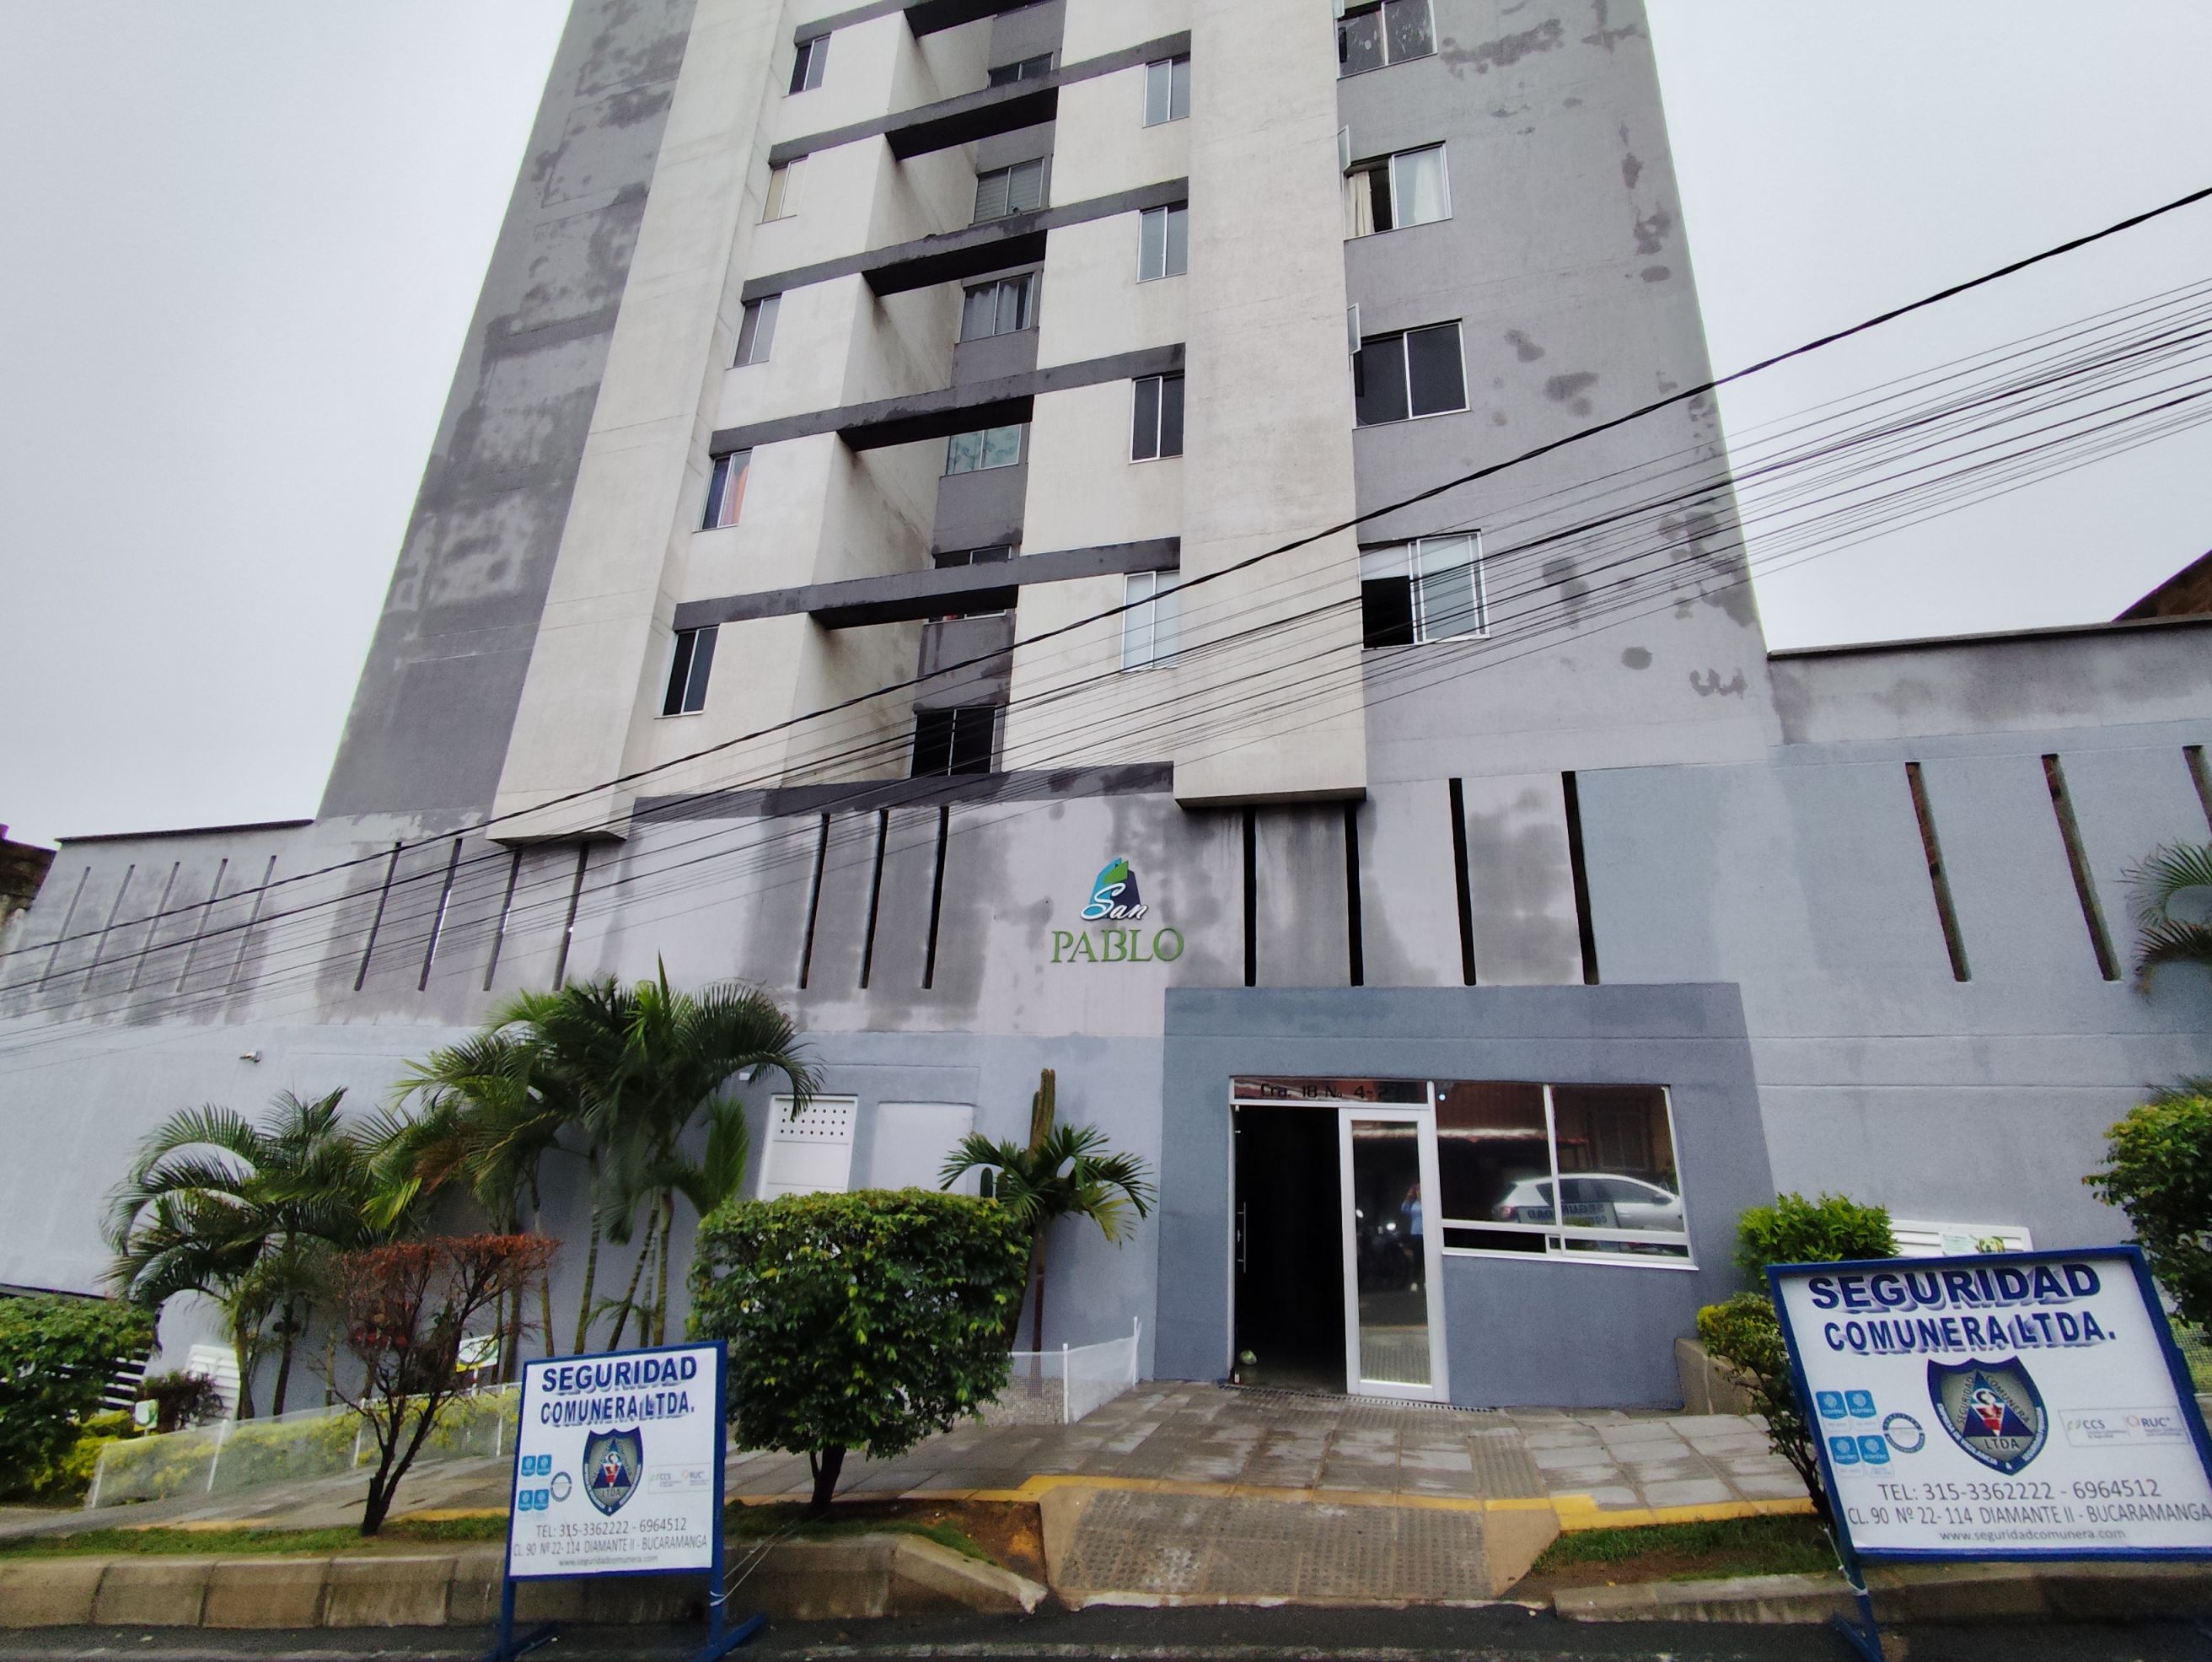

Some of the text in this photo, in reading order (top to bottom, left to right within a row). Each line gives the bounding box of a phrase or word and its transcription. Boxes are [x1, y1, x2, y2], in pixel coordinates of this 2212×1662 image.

[1080, 883, 1148, 921] San
[1050, 928, 1184, 963] PABLO
[1261, 1084, 1291, 1097] Cra.
[1302, 1085, 1318, 1098] 18
[1808, 1263, 2102, 1310] SEGURIDAD
[1825, 1310, 2117, 1351] COMUNERA LTDA.
[542, 1356, 697, 1393] SEGURIDAD
[540, 1391, 695, 1424] COMUNERA LTDA.
[1957, 1376, 1975, 1424] SEGURIDAD
[1985, 1375, 2031, 1423] COMUNERA
[2082, 1419, 2106, 1429] CCS
[1984, 1439, 2021, 1451] LTDA
[1877, 1483, 1918, 1501] TEL:
[1923, 1482, 2054, 1501] 315-3362222
[2073, 1478, 2161, 1499] 6964512
[537, 1525, 556, 1538] TEL:
[560, 1521, 629, 1537] 315-3362222
[639, 1517, 687, 1532] 6964512
[1848, 1507, 1869, 1525] CL.
[1871, 1507, 1890, 1525] 90
[1979, 1505, 2061, 1525] DIAMANTE
[2086, 1503, 2212, 1523] BUCARAMANGA
[526, 1542, 537, 1556] 90
[584, 1539, 628, 1553] DIAMANTE
[642, 1535, 707, 1550] BUCARAMANGA
[1940, 1529, 2126, 1542] www.seguridadcomunera.com
